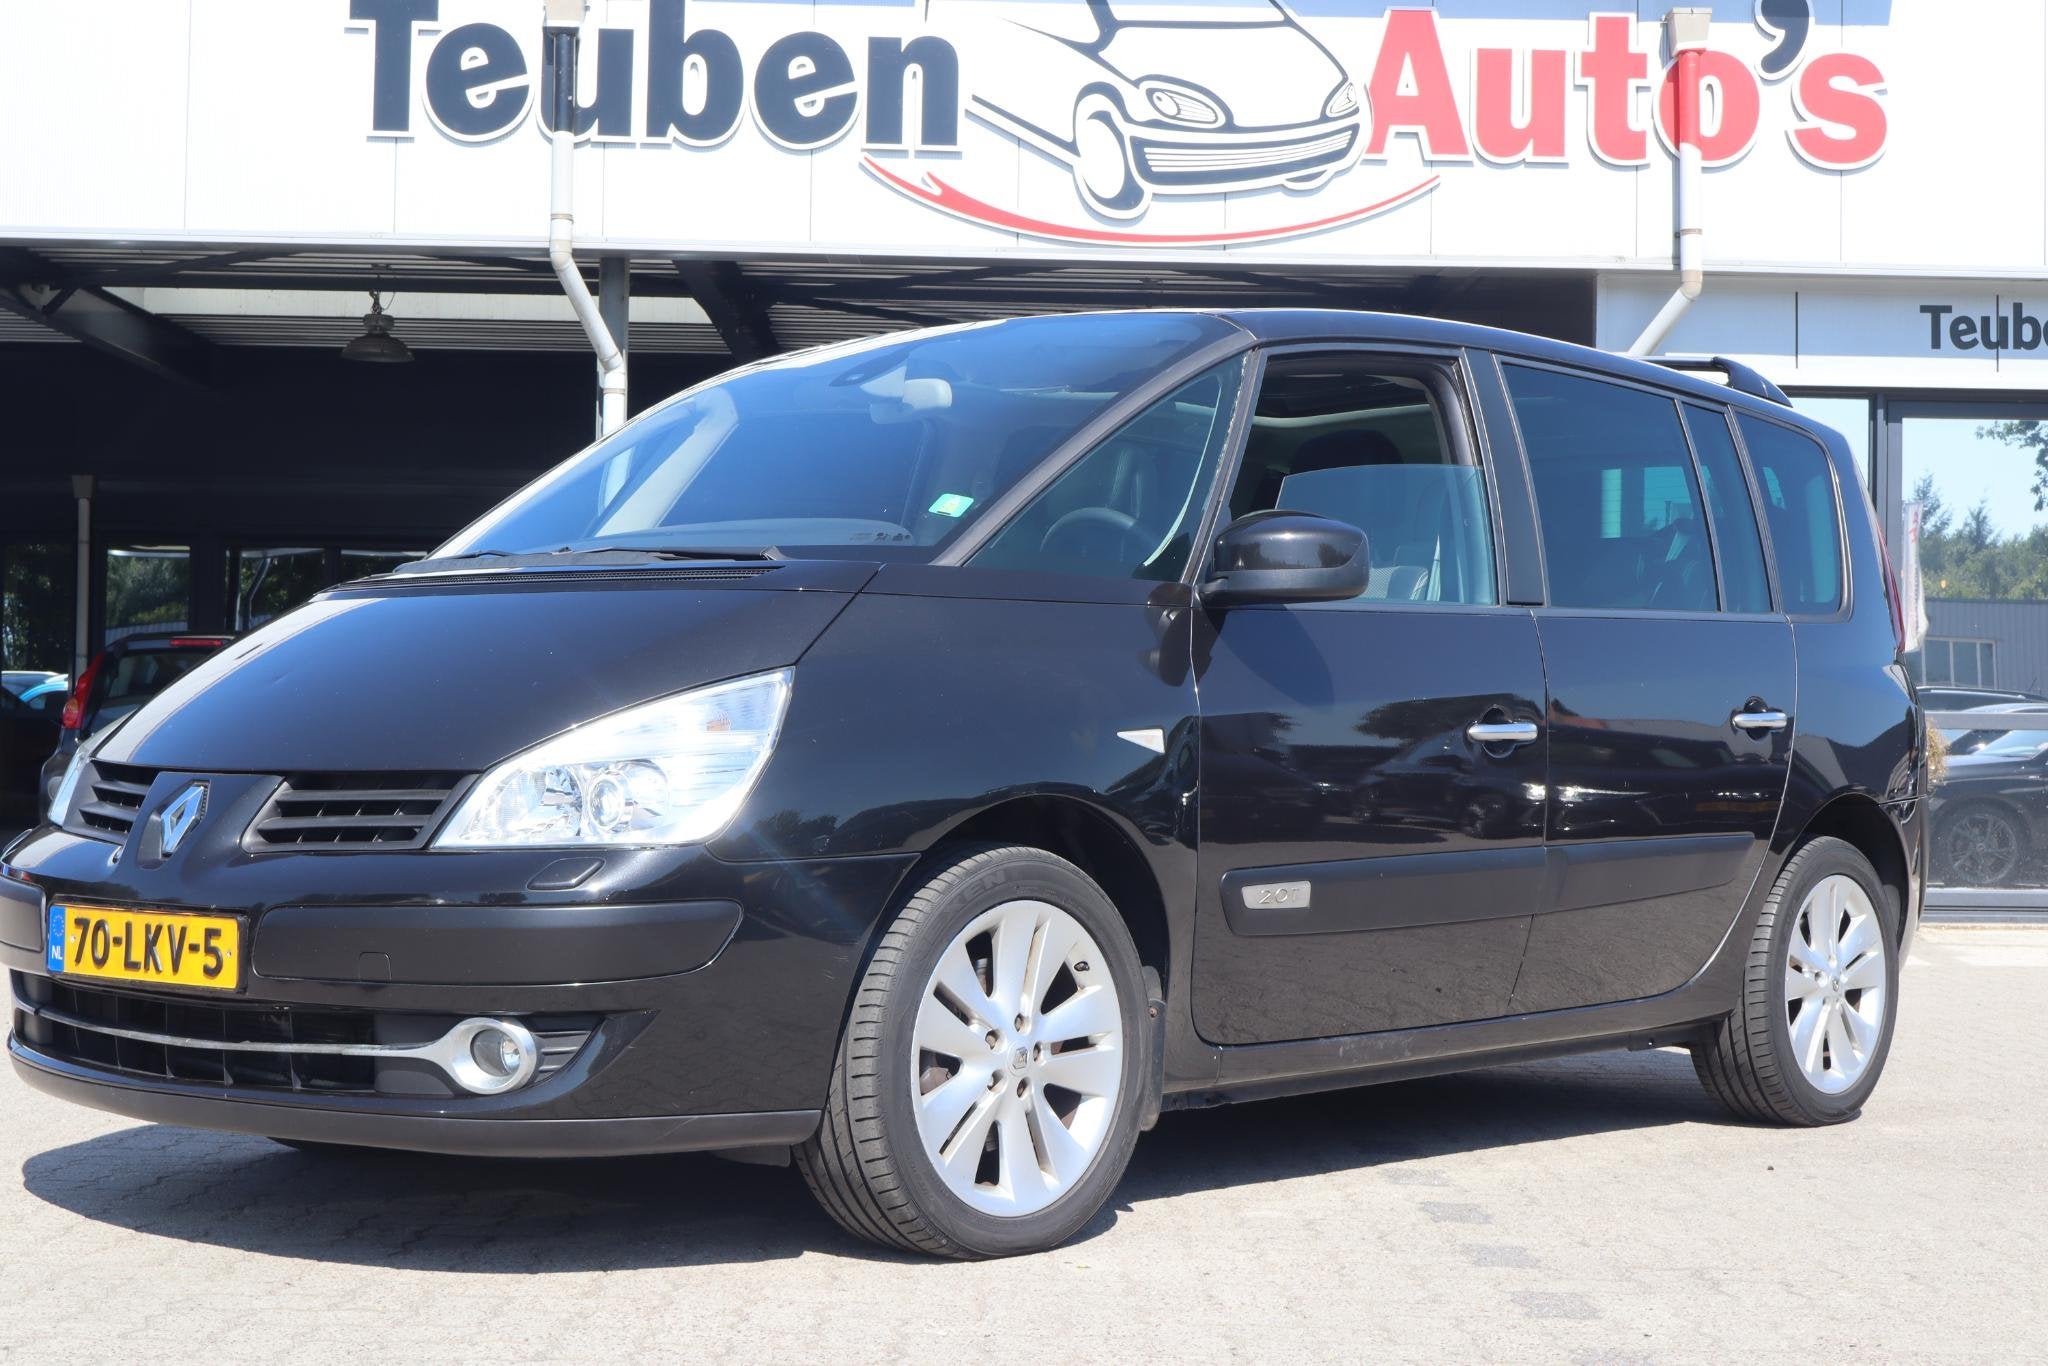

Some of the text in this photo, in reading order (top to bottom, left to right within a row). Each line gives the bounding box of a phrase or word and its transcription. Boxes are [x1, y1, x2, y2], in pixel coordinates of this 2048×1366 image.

[349, 0, 1888, 164] Teuben Auto's
[1920, 302, 2048, 350] Teub
[51, 945, 63, 960] NL
[74, 917, 223, 978] 70-LKV-5
